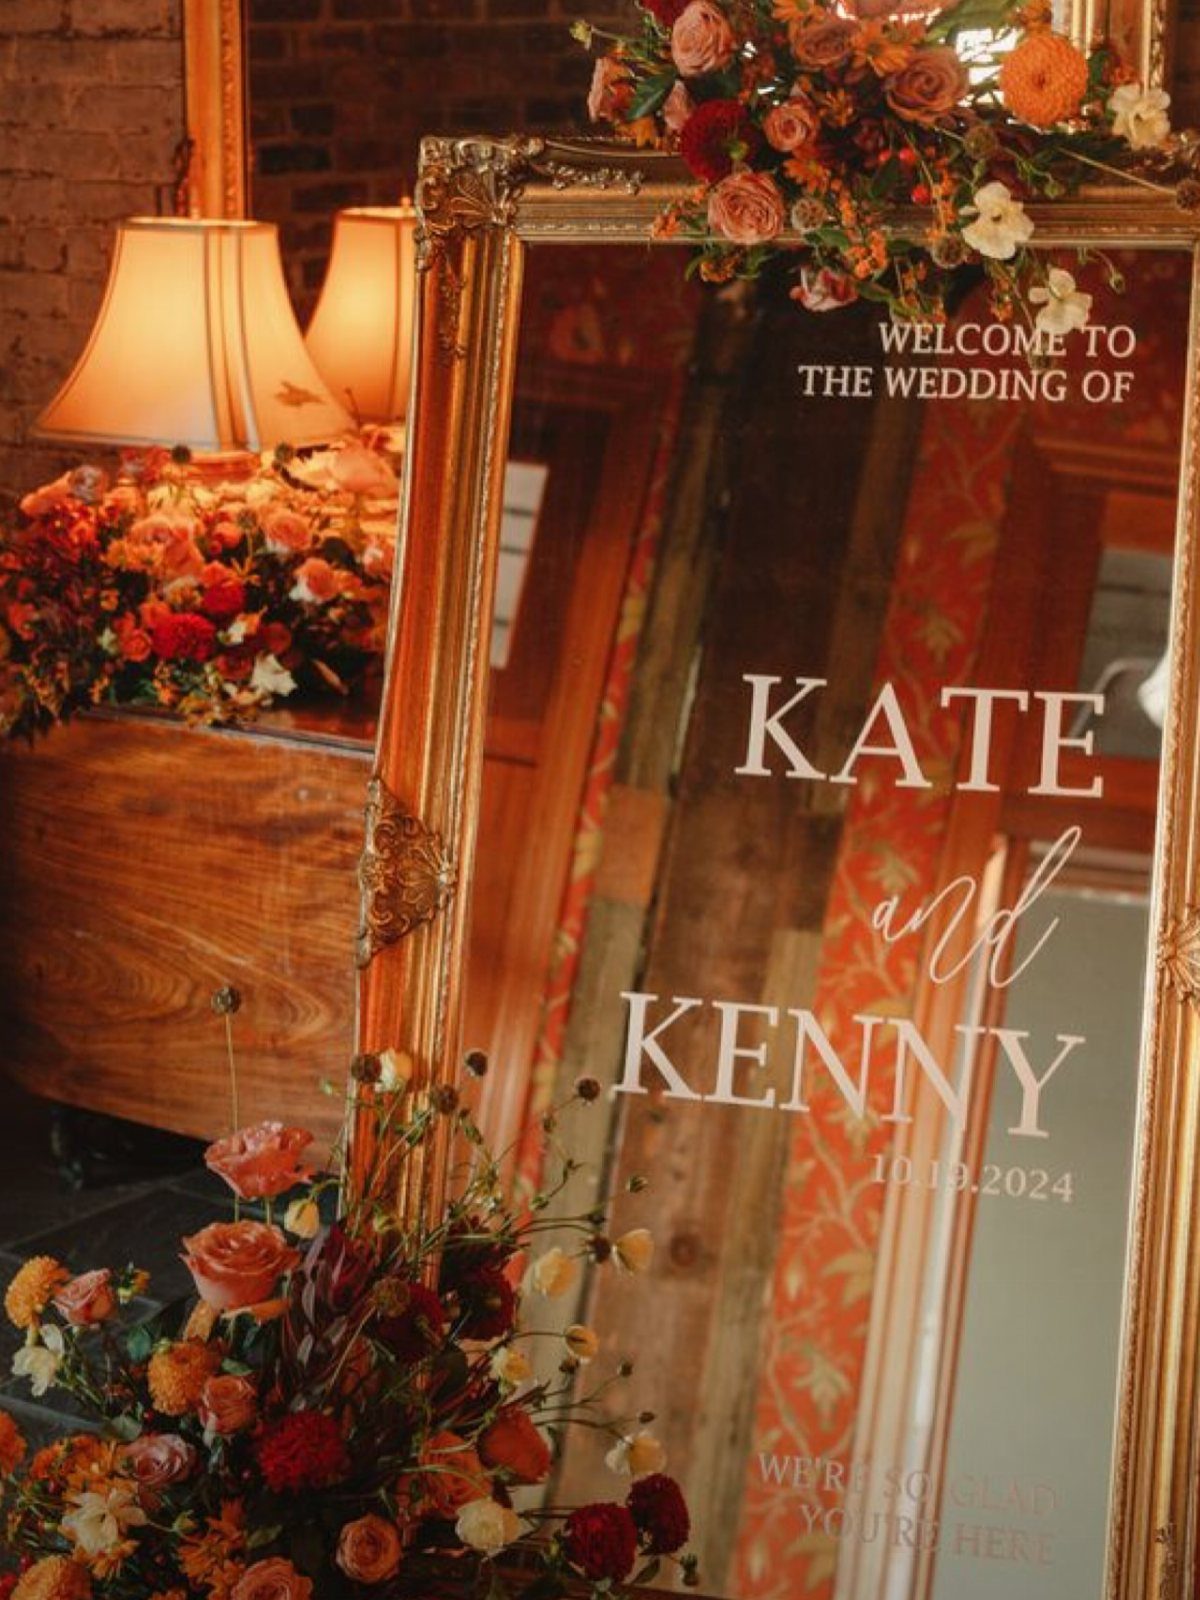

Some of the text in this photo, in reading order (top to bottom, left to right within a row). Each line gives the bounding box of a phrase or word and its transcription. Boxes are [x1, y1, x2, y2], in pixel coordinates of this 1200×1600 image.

[879, 322, 1137, 359] WELCOME TO
[798, 365, 1135, 403] THE WEDDING OF
[734, 673, 1104, 798] KATE
[872, 825, 1082, 988] and
[612, 991, 1086, 1138] KENNY
[871, 1153, 1074, 1203] 10.19.2024
[883, 1466, 932, 1503] SO
[955, 1522, 1057, 1566] HERE
